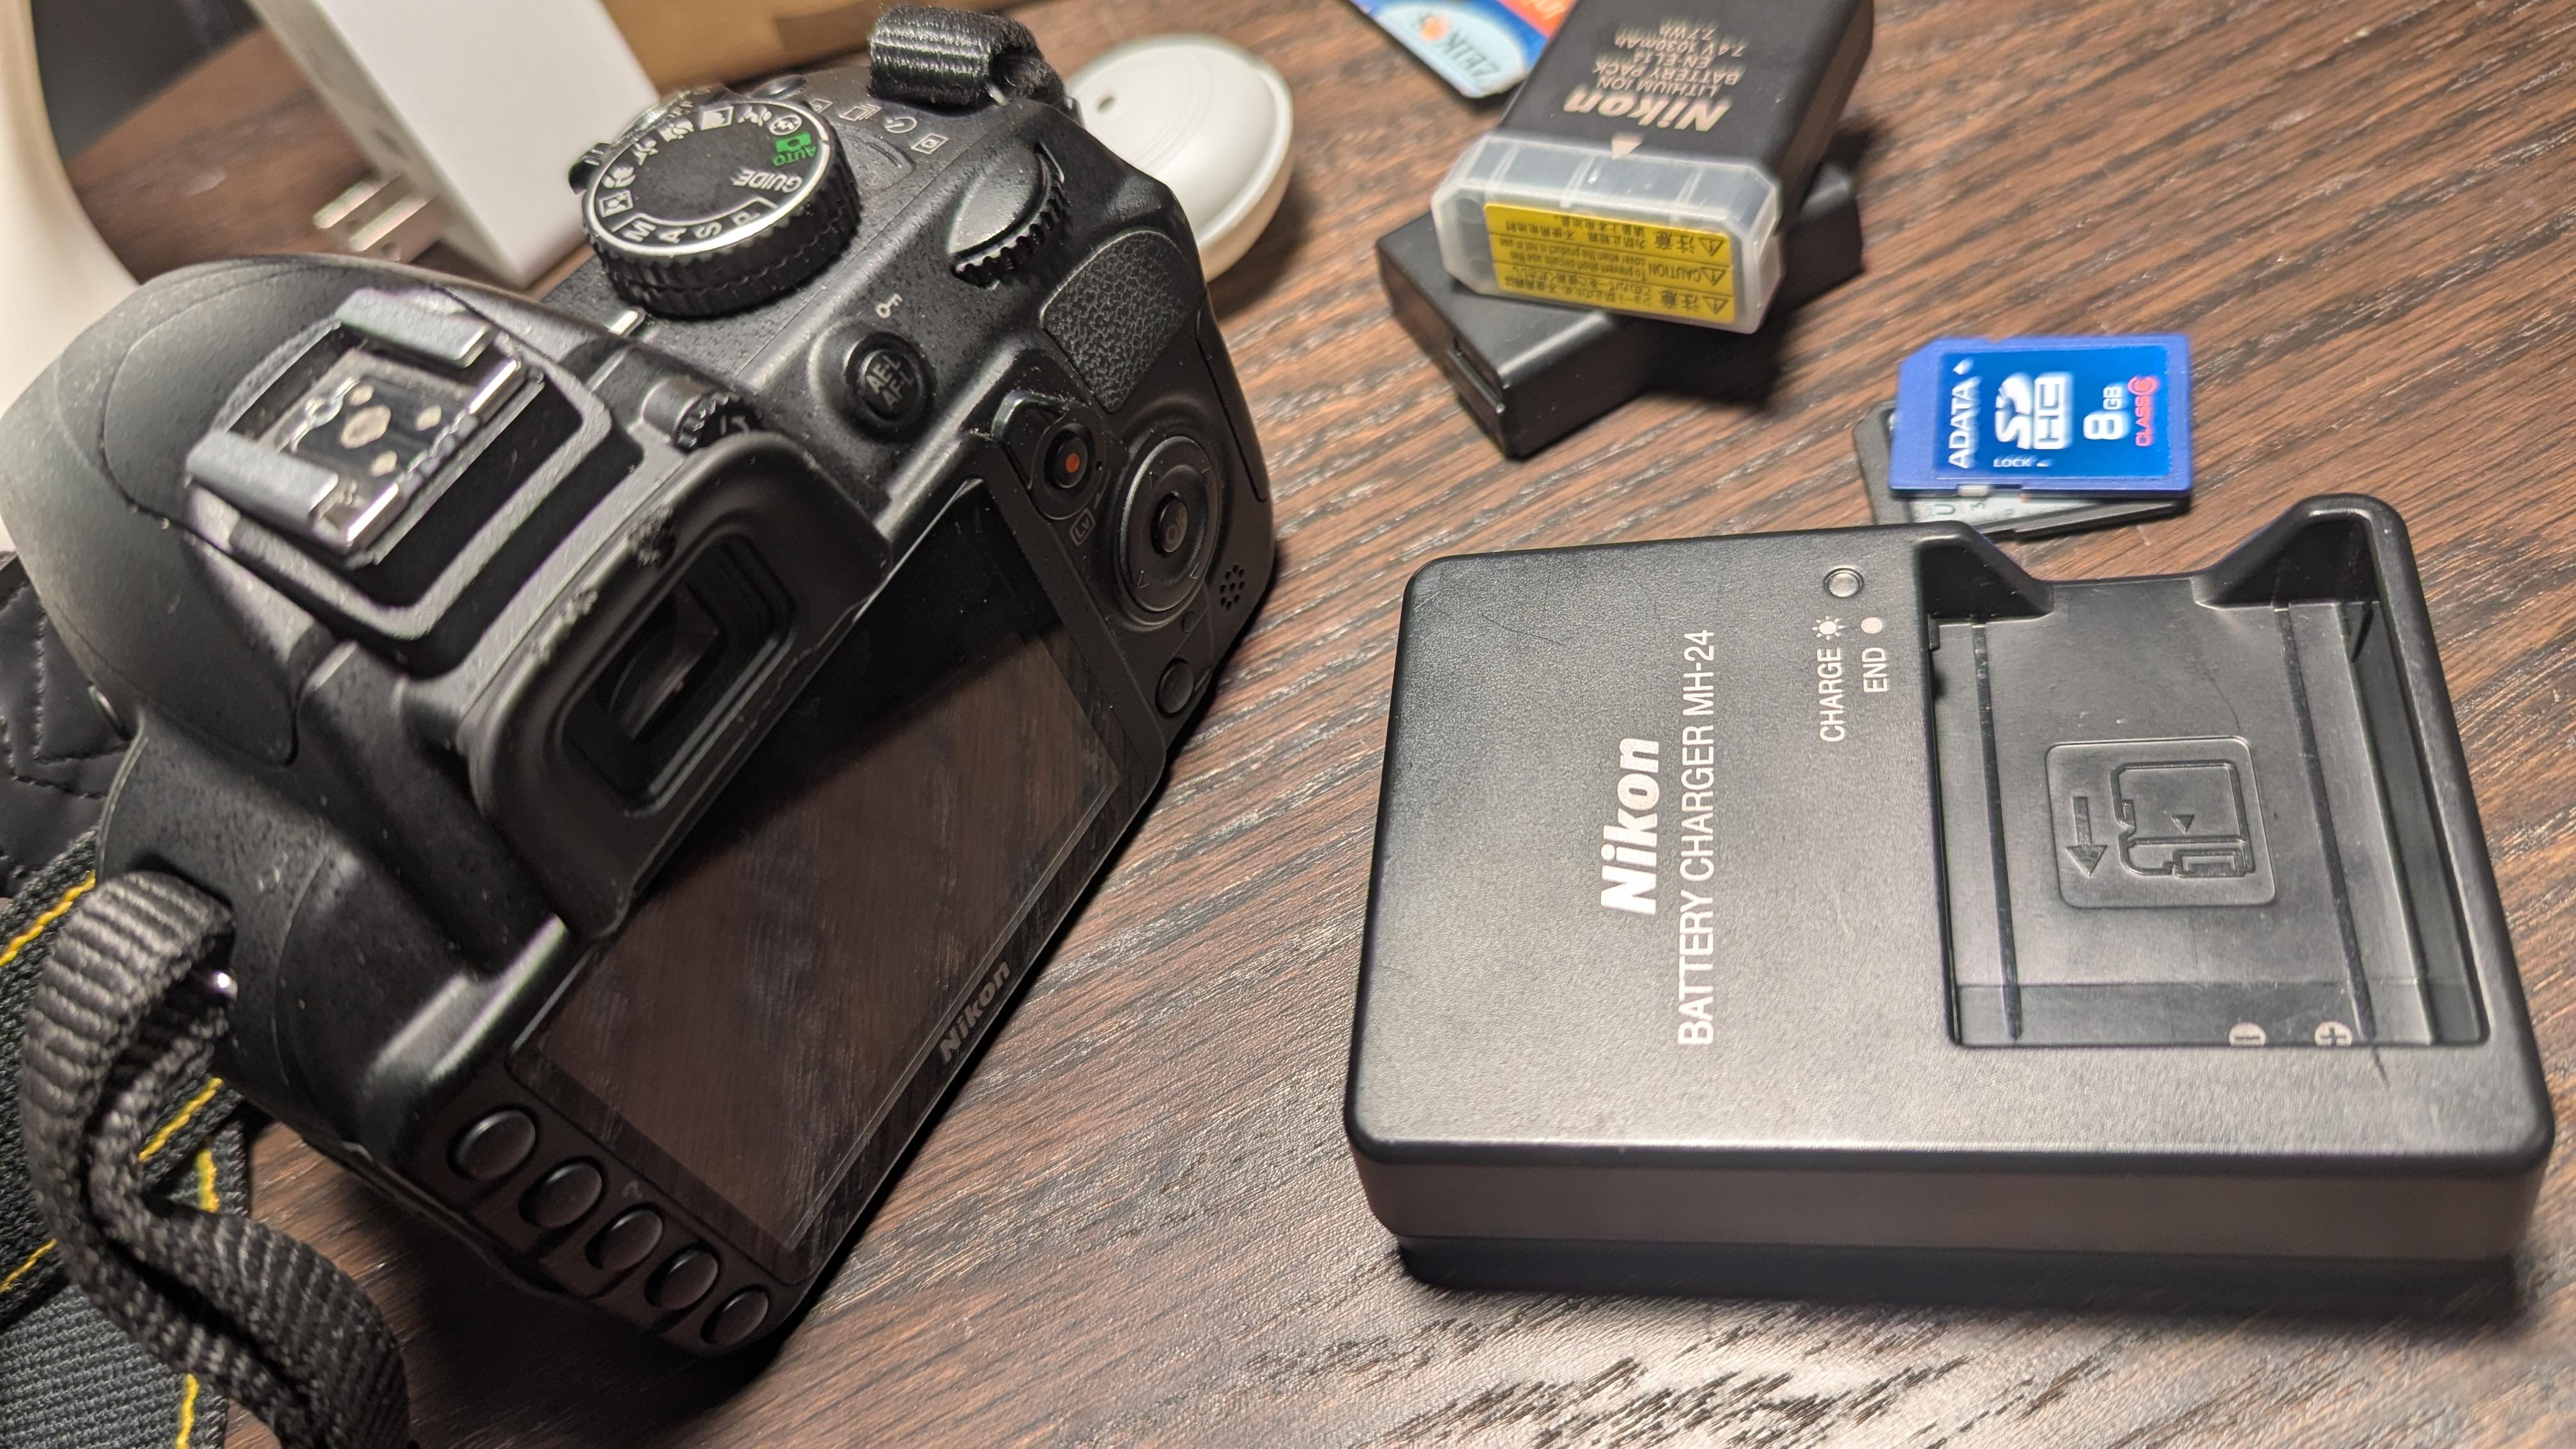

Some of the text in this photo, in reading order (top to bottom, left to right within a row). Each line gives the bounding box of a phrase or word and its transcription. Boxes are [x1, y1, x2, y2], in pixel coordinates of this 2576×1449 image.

[1592, 59, 1743, 85] BATTERY PACK
[1597, 76, 1720, 98] LITHIUM ION
[1563, 88, 1731, 132] Nikon
[772, 146, 816, 166] AUTO
[732, 168, 803, 193] GUIDE
[623, 211, 762, 244] M A S P
[1648, 263, 1701, 282] CAUTION
[866, 355, 901, 394] AE-L
[882, 371, 914, 409] AF-L
[1949, 376, 1979, 469] ADATA
[2083, 384, 2128, 440] 8 GB
[2135, 394, 2153, 447] CLASS
[1993, 456, 2032, 467] LOCK
[1862, 647, 1889, 693] END
[1818, 647, 1846, 742] CHARGE
[1600, 738, 1659, 915] Nikon
[1678, 629, 1714, 1045] BATTERY CHARGER MH-24
[940, 961, 1010, 1063] Nikon
